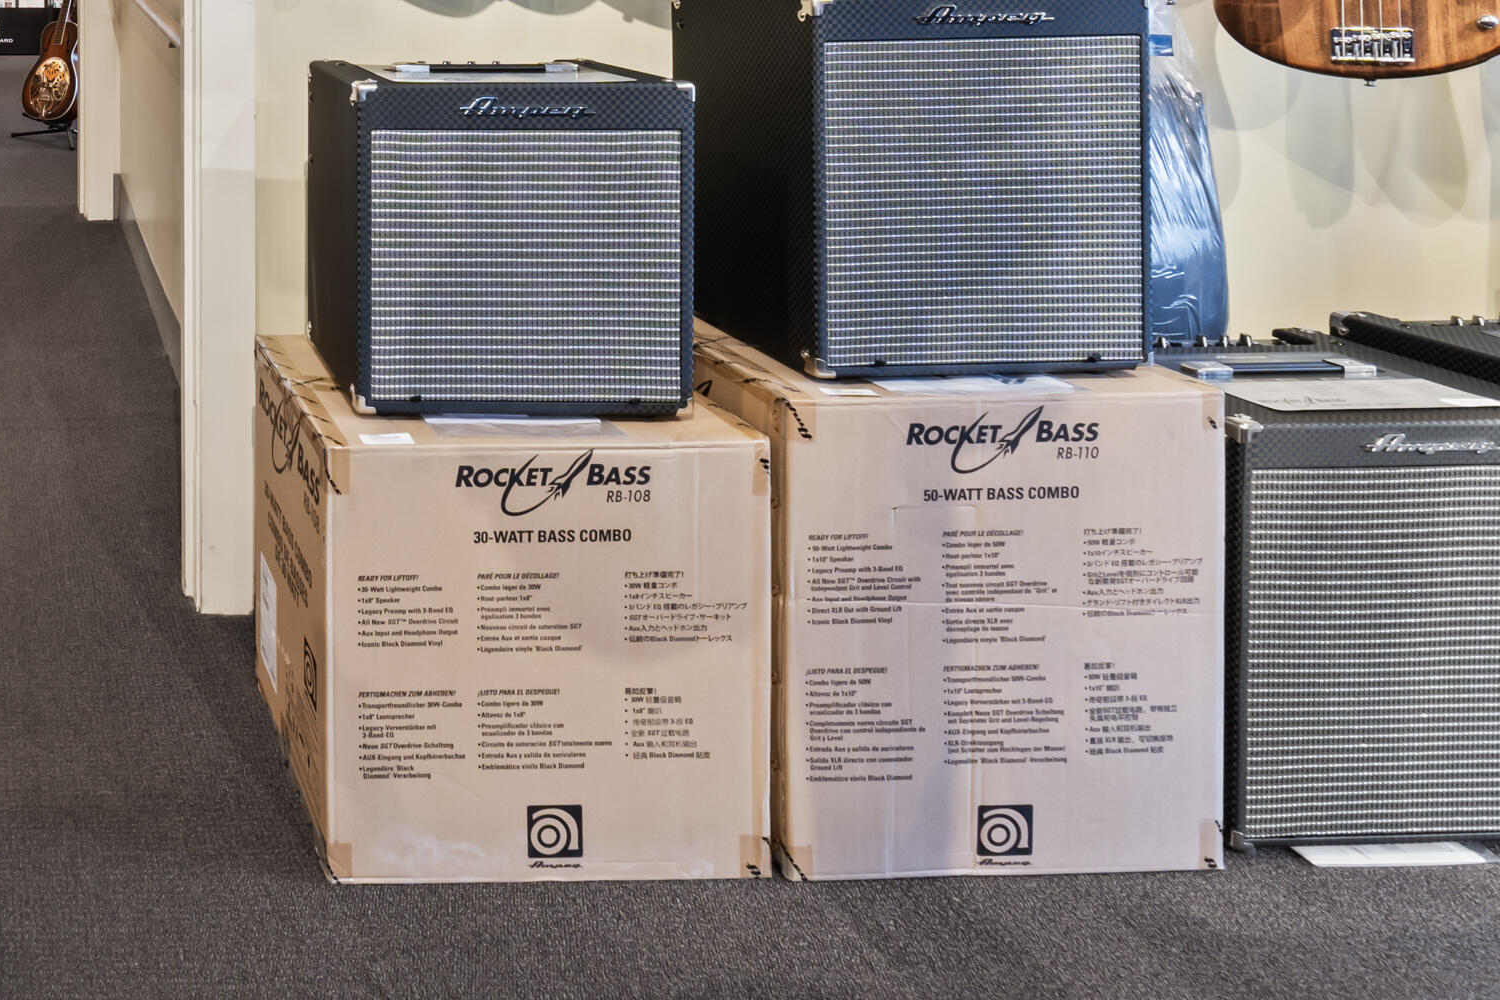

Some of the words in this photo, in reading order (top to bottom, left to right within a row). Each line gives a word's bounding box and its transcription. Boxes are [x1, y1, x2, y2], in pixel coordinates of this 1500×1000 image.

[913, 4, 1056, 27] Ampeg
[459, 96, 597, 119] Ampeg
[906, 413, 1002, 447] ROCKET
[1035, 420, 1100, 443] BASS
[1056, 446, 1100, 460] RB-110
[297, 441, 321, 506] BASS
[455, 456, 553, 490] ROCKET
[586, 463, 652, 486] BASS
[606, 489, 651, 504] RB-108
[923, 488, 983, 502] 50-WATT
[987, 487, 1025, 501] BASS
[1028, 485, 1080, 500] COMBO
[473, 530, 534, 544] 30-WATT
[537, 529, 576, 543] BASS
[579, 528, 632, 542] COMBO
